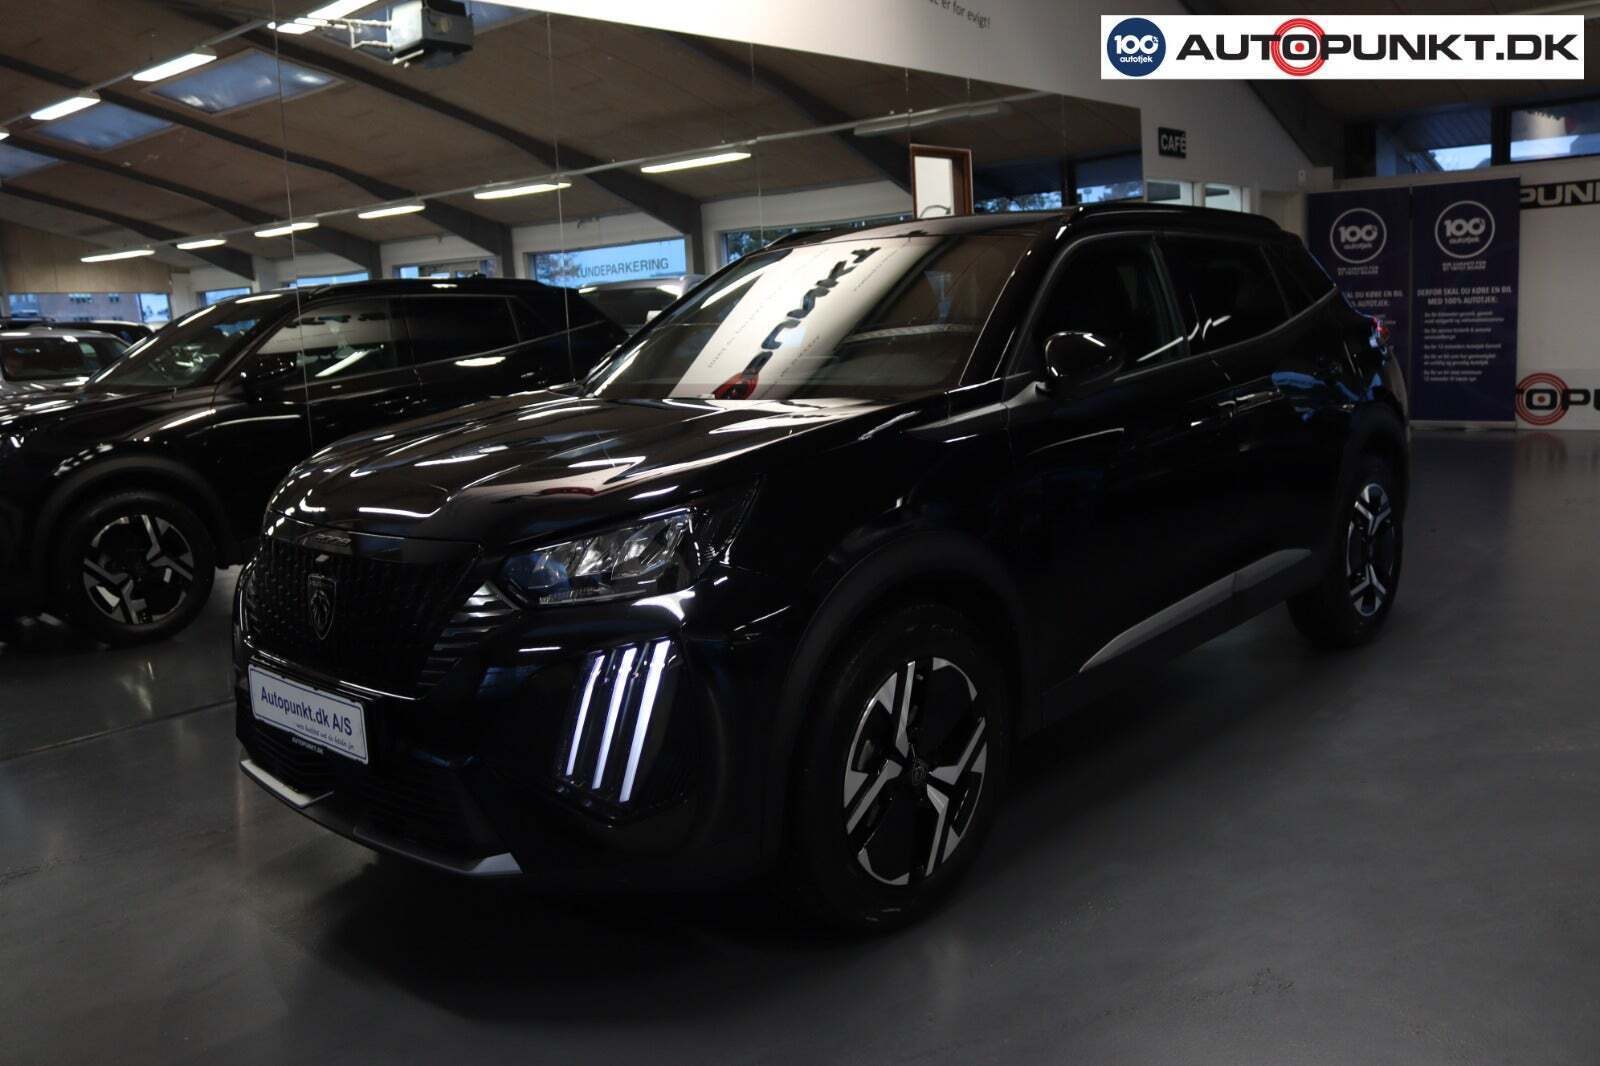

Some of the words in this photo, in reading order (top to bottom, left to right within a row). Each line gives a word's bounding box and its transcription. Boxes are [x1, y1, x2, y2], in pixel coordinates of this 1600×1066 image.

[1520, 181, 1600, 207] PUN
[573, 257, 669, 280] KUNDEPARKERING
[261, 686, 331, 728] Autopunkt.dk
[332, 712, 353, 736] A/S
